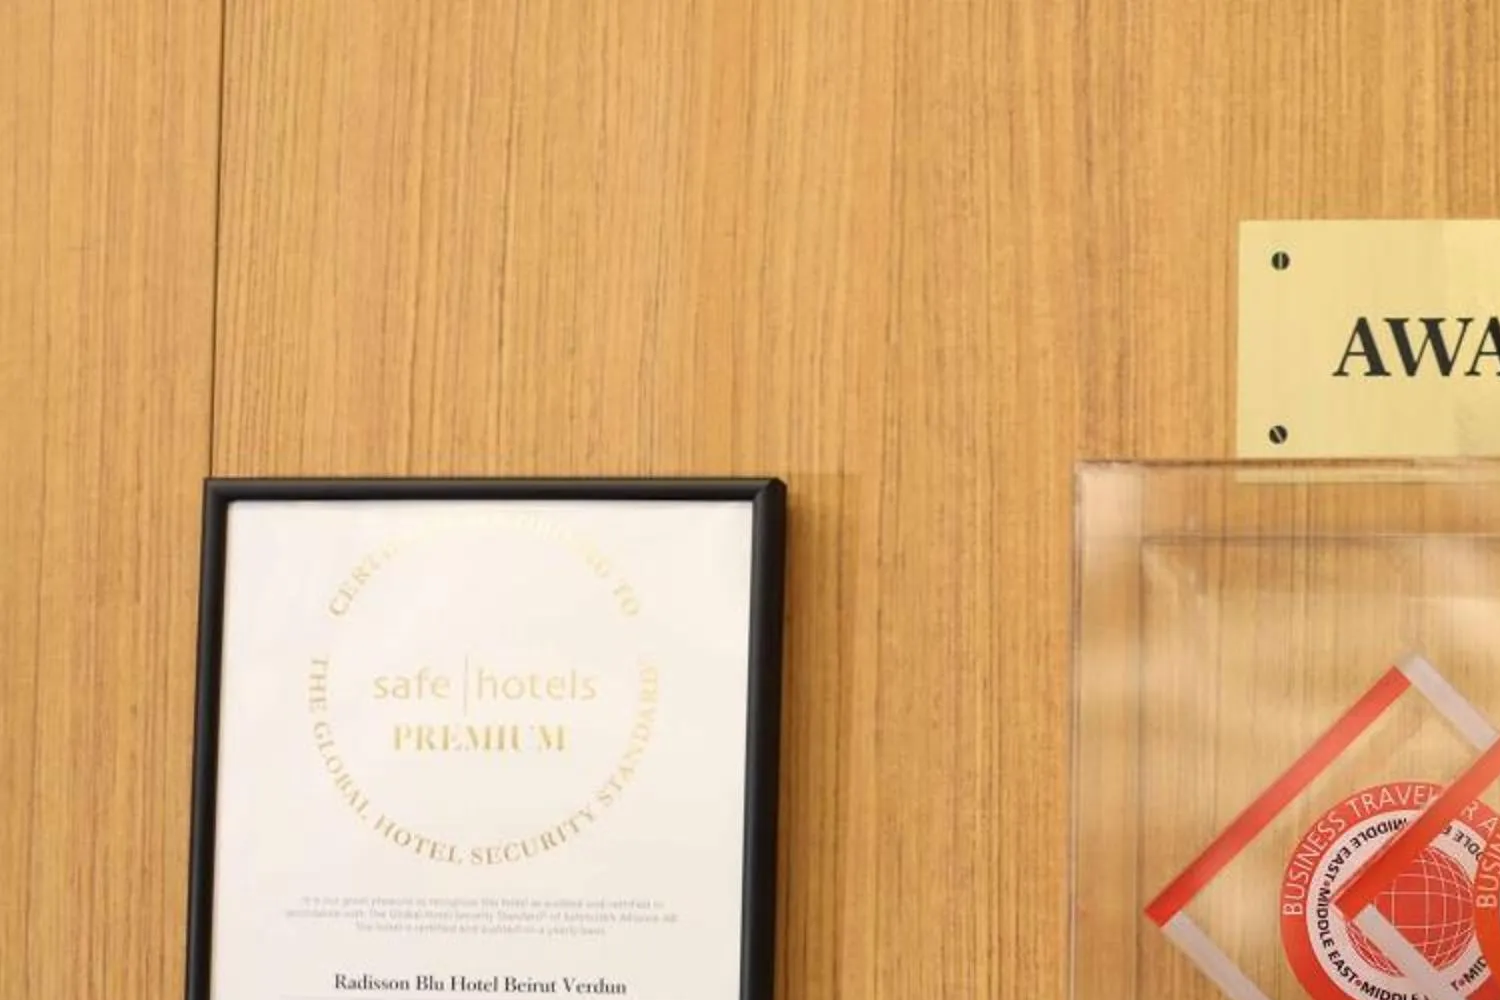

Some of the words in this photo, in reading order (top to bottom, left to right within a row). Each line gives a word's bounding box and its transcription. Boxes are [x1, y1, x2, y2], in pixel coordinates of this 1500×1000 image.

[309, 656, 328, 714] THE
[374, 667, 450, 700] safe
[476, 667, 597, 701] hotels
[393, 723, 566, 752] PREMIUM
[312, 721, 370, 821] GLOBAL
[374, 813, 463, 865] HOTEL
[470, 806, 597, 866] SECURITY
[1283, 812, 1345, 915] BUSINESS
[1326, 846, 1351, 882] EAST
[1316, 887, 1335, 948] MIDDLE
[1328, 949, 1358, 986] EAST
[334, 973, 410, 991] Radisson
[416, 975, 445, 992] Blu
[450, 976, 498, 993] Hotel
[504, 977, 556, 994] Beirut
[562, 978, 627, 995] Verdun
